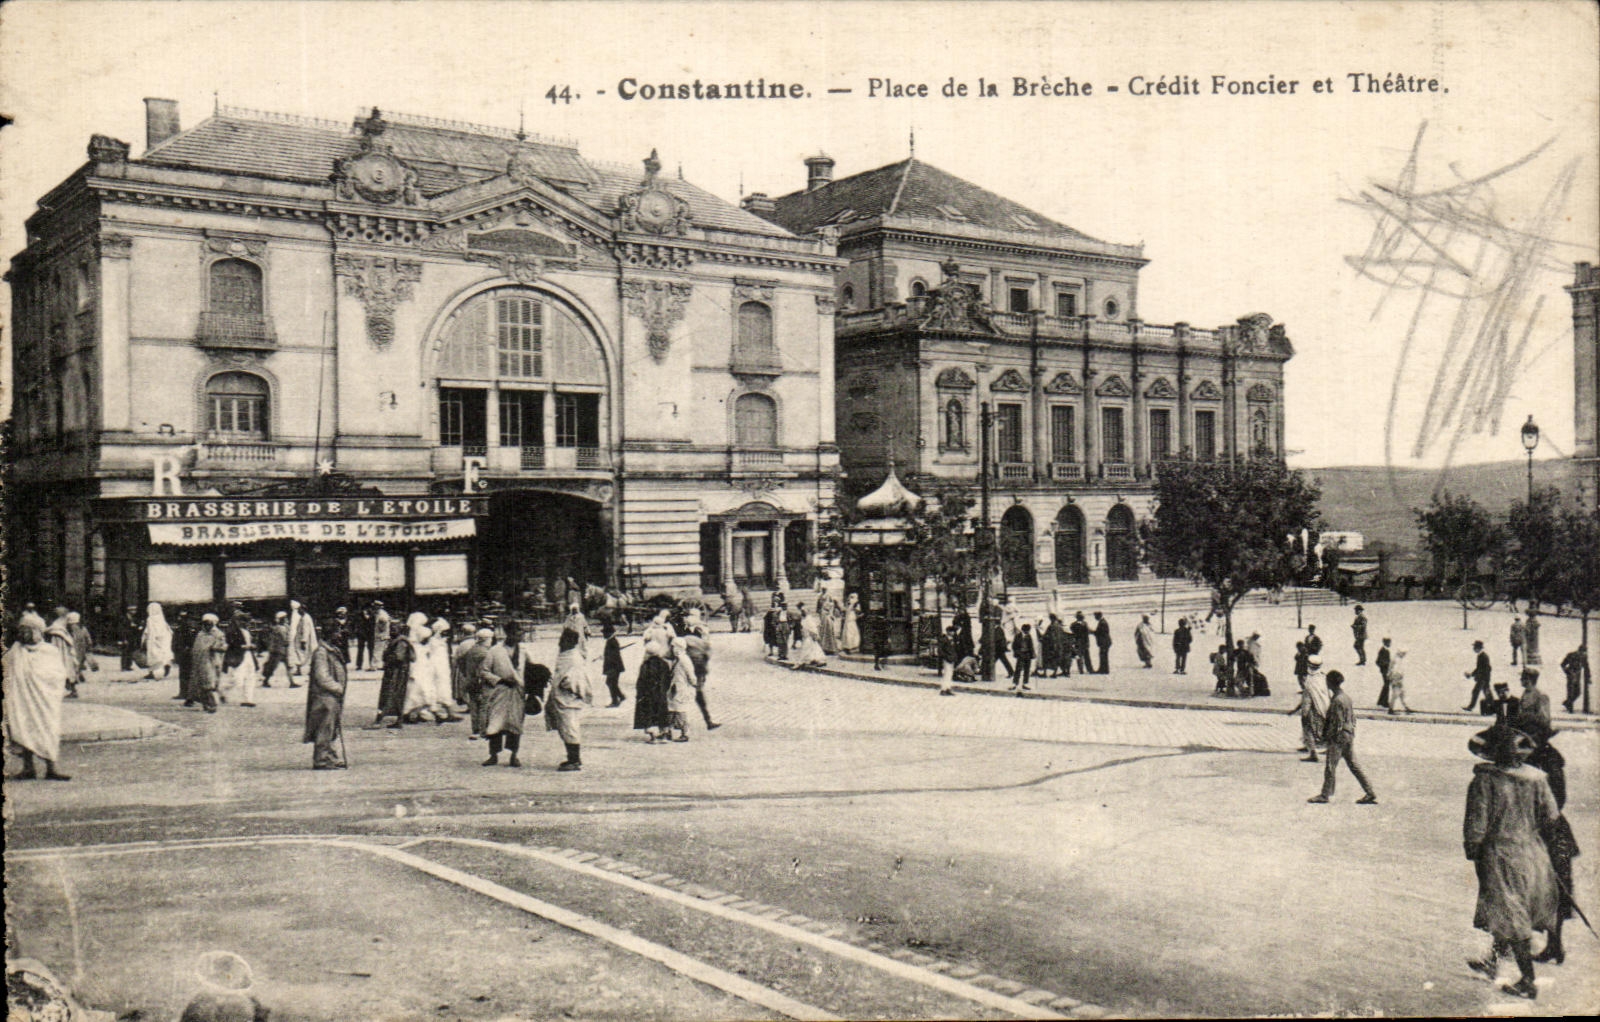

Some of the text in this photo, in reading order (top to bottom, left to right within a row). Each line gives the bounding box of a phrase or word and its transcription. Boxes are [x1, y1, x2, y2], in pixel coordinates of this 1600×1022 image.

[147, 499, 472, 518] BRASSERIE DE L'ETOILE
[321, 524, 347, 537] DE
